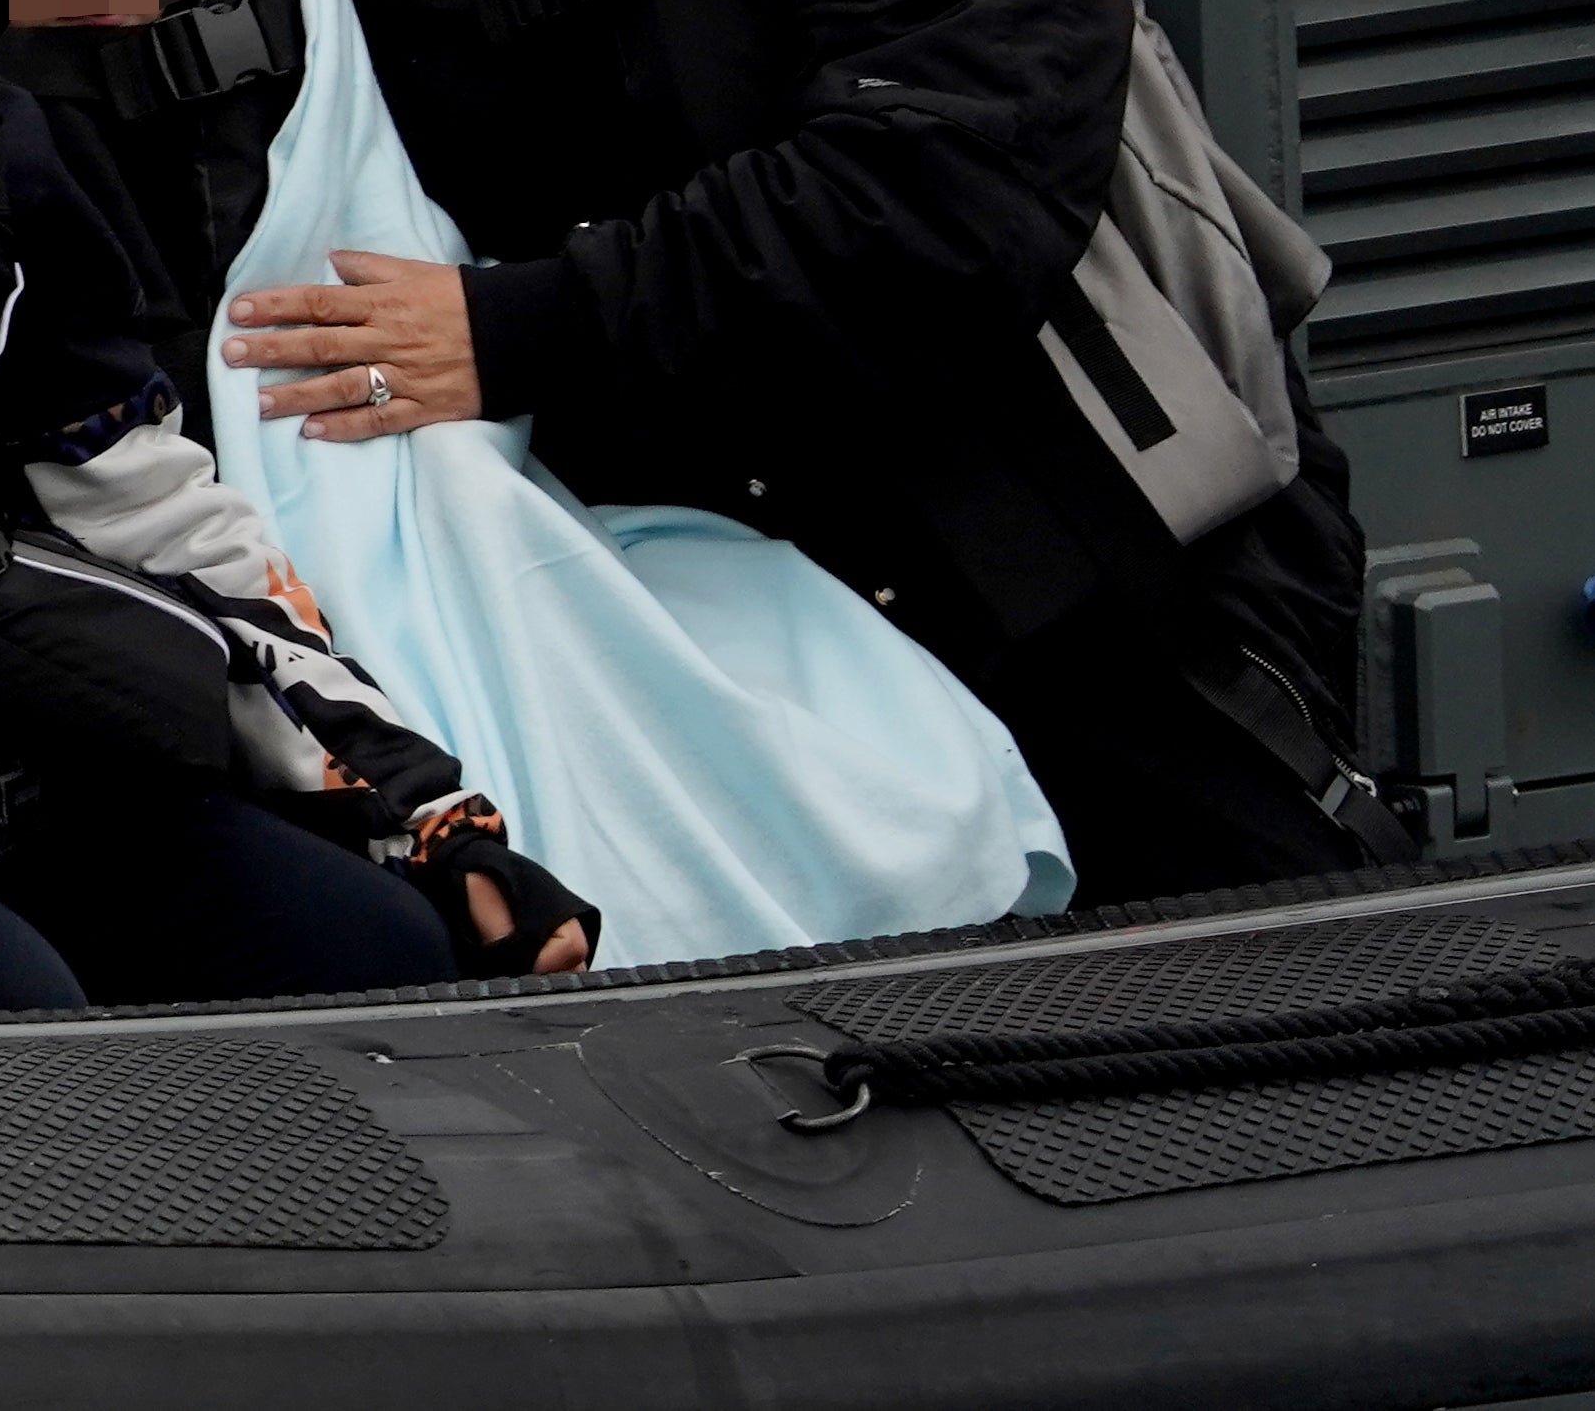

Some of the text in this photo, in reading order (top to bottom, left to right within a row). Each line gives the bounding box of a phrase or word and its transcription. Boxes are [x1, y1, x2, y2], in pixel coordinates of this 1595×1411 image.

[1480, 402, 1533, 422] AIR INTAKE
[1471, 417, 1544, 438] DO NOT COVER
